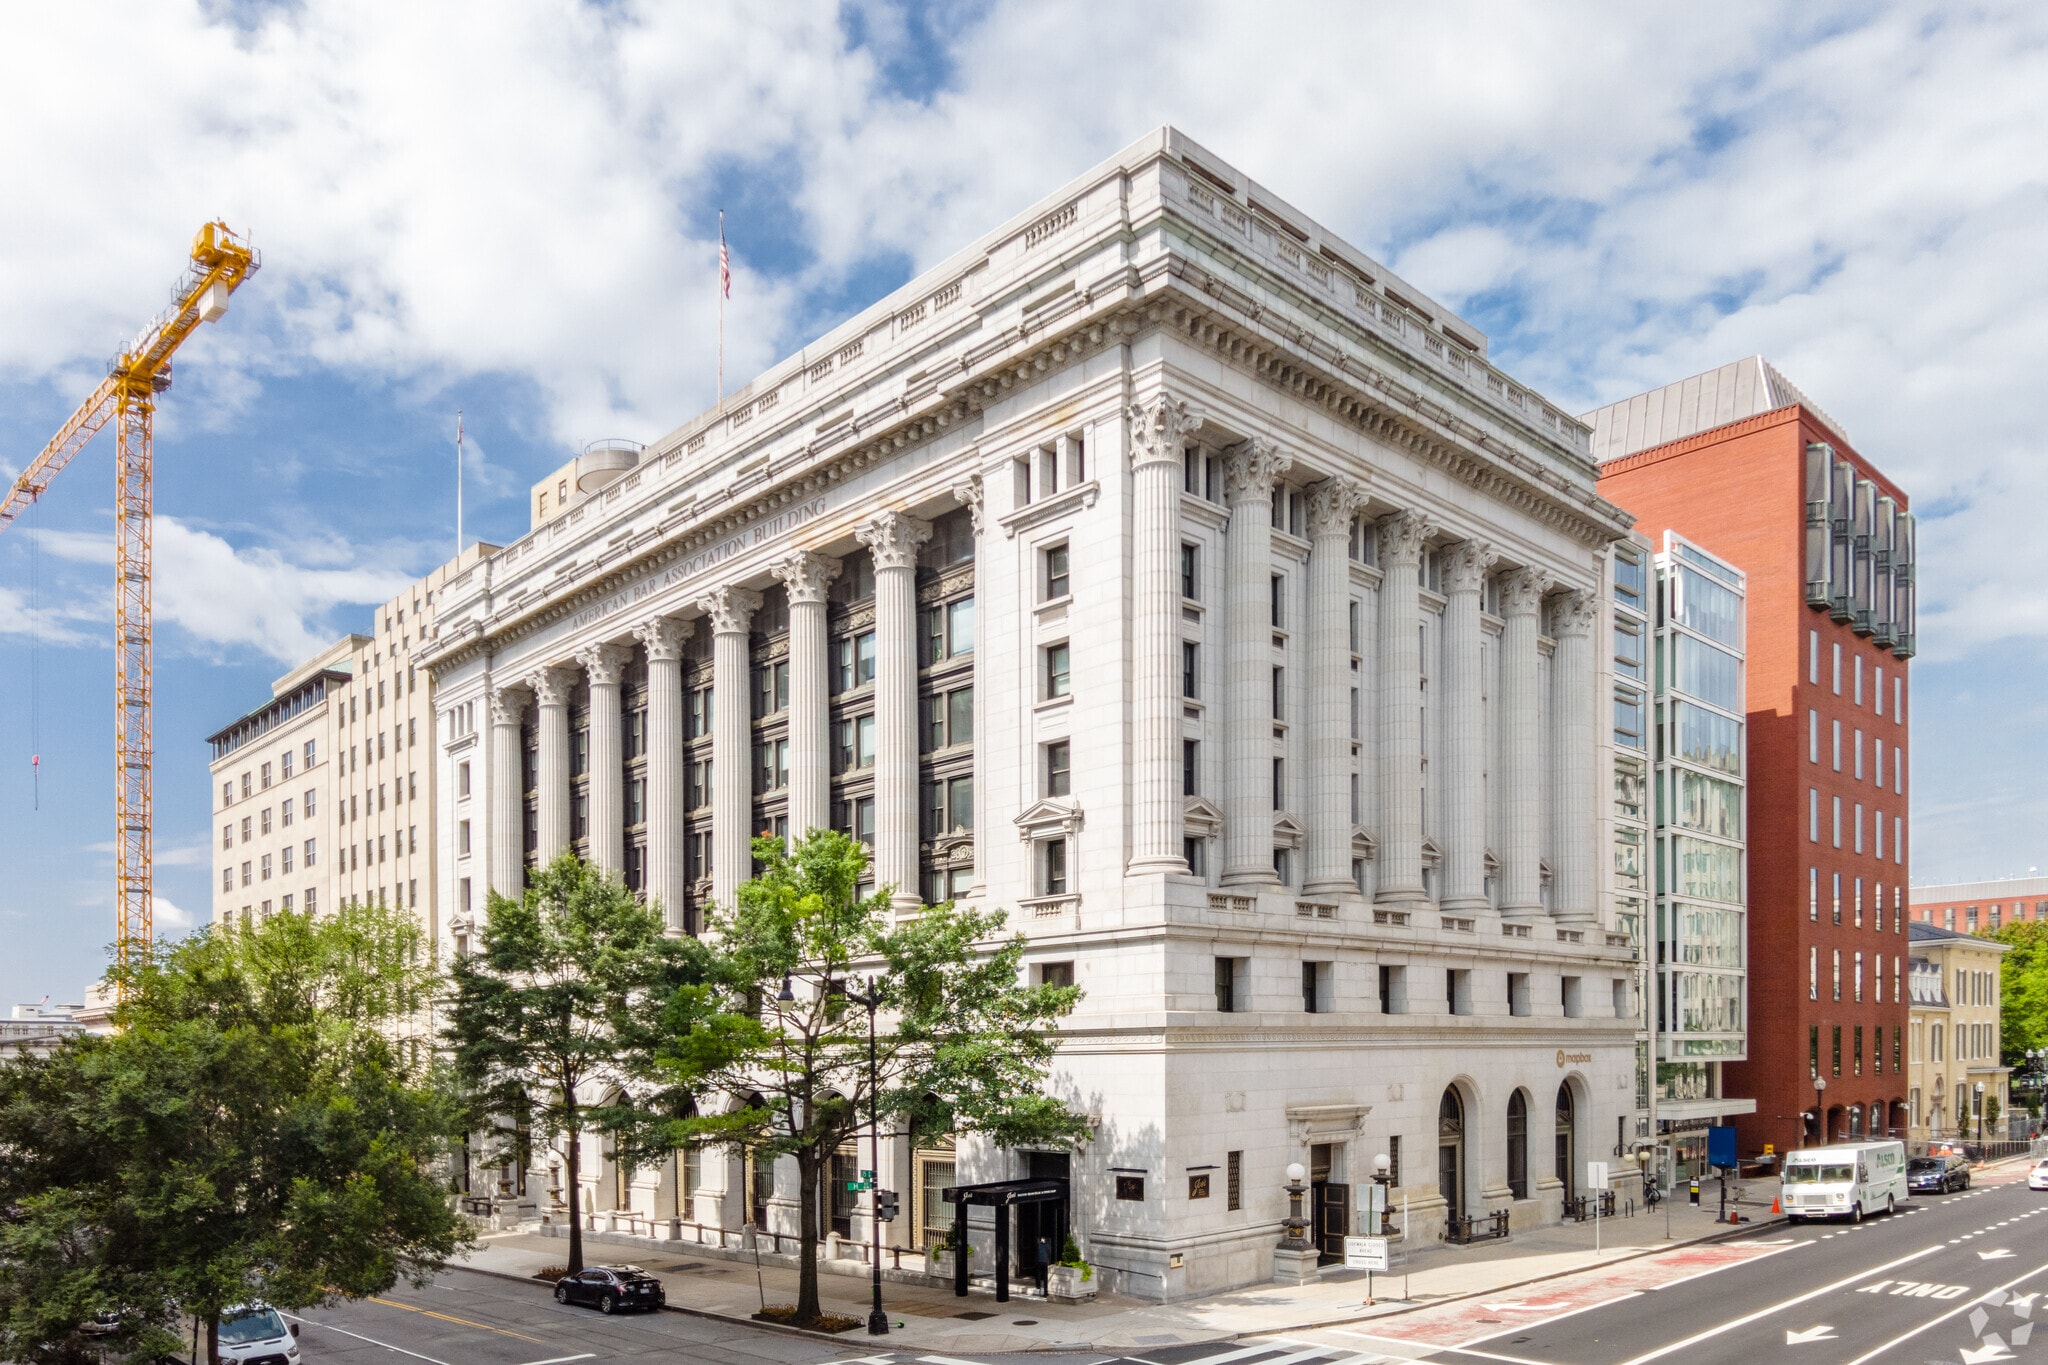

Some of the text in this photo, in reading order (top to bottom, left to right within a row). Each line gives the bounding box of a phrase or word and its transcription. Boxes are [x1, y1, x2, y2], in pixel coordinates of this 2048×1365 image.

[572, 497, 827, 631] AMERICAN BAR ASSOCIATION BUILDING
[1566, 1051, 1592, 1065] mapbox
[1856, 1280, 1970, 1299] ONLY
